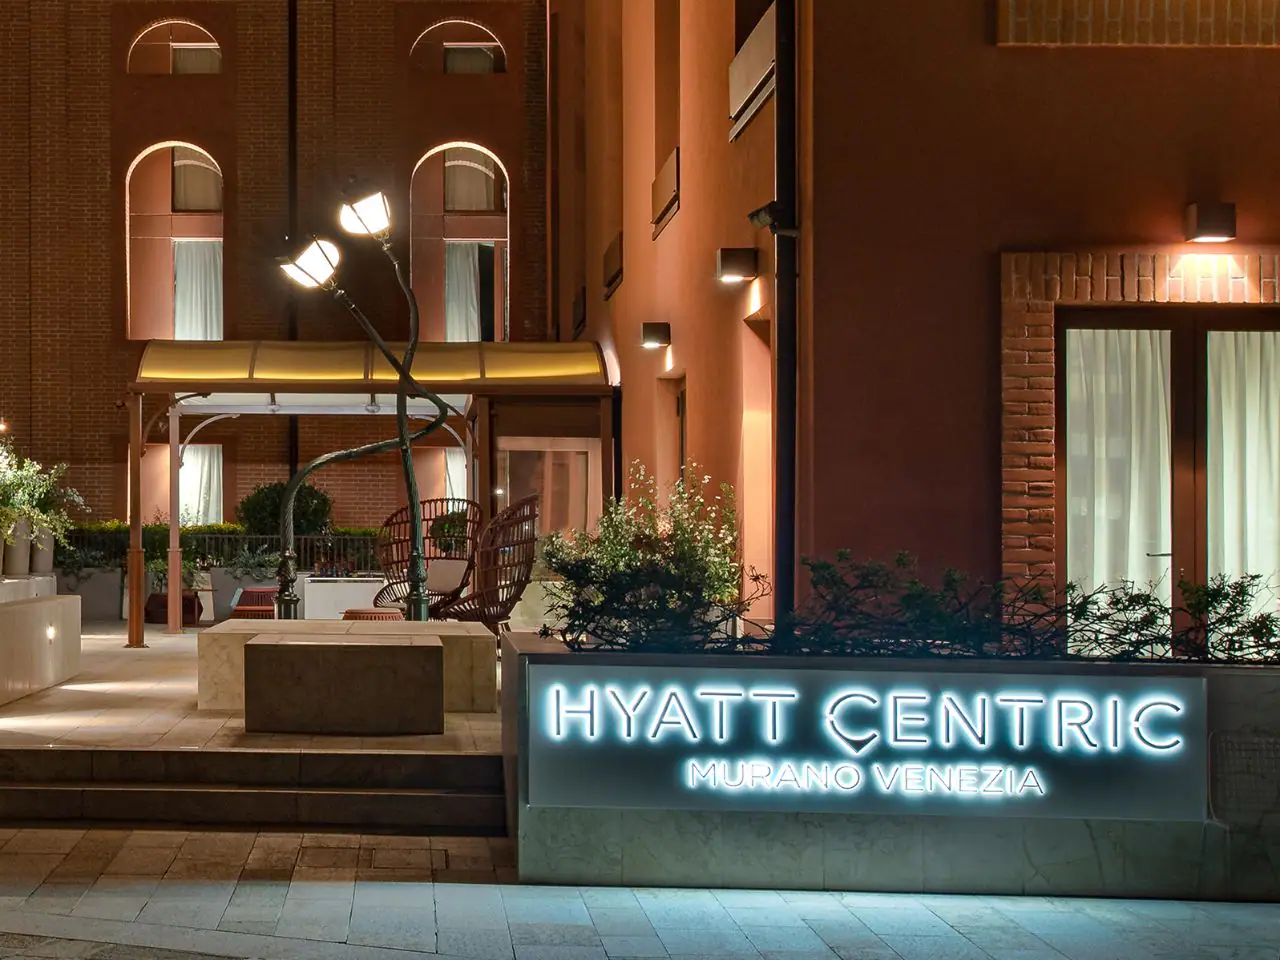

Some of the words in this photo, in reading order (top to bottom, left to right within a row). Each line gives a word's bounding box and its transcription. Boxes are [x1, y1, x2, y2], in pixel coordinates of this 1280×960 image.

[552, 687, 797, 742] HYATT
[688, 762, 860, 791] MURANO
[874, 765, 1045, 795] VENEZIA
